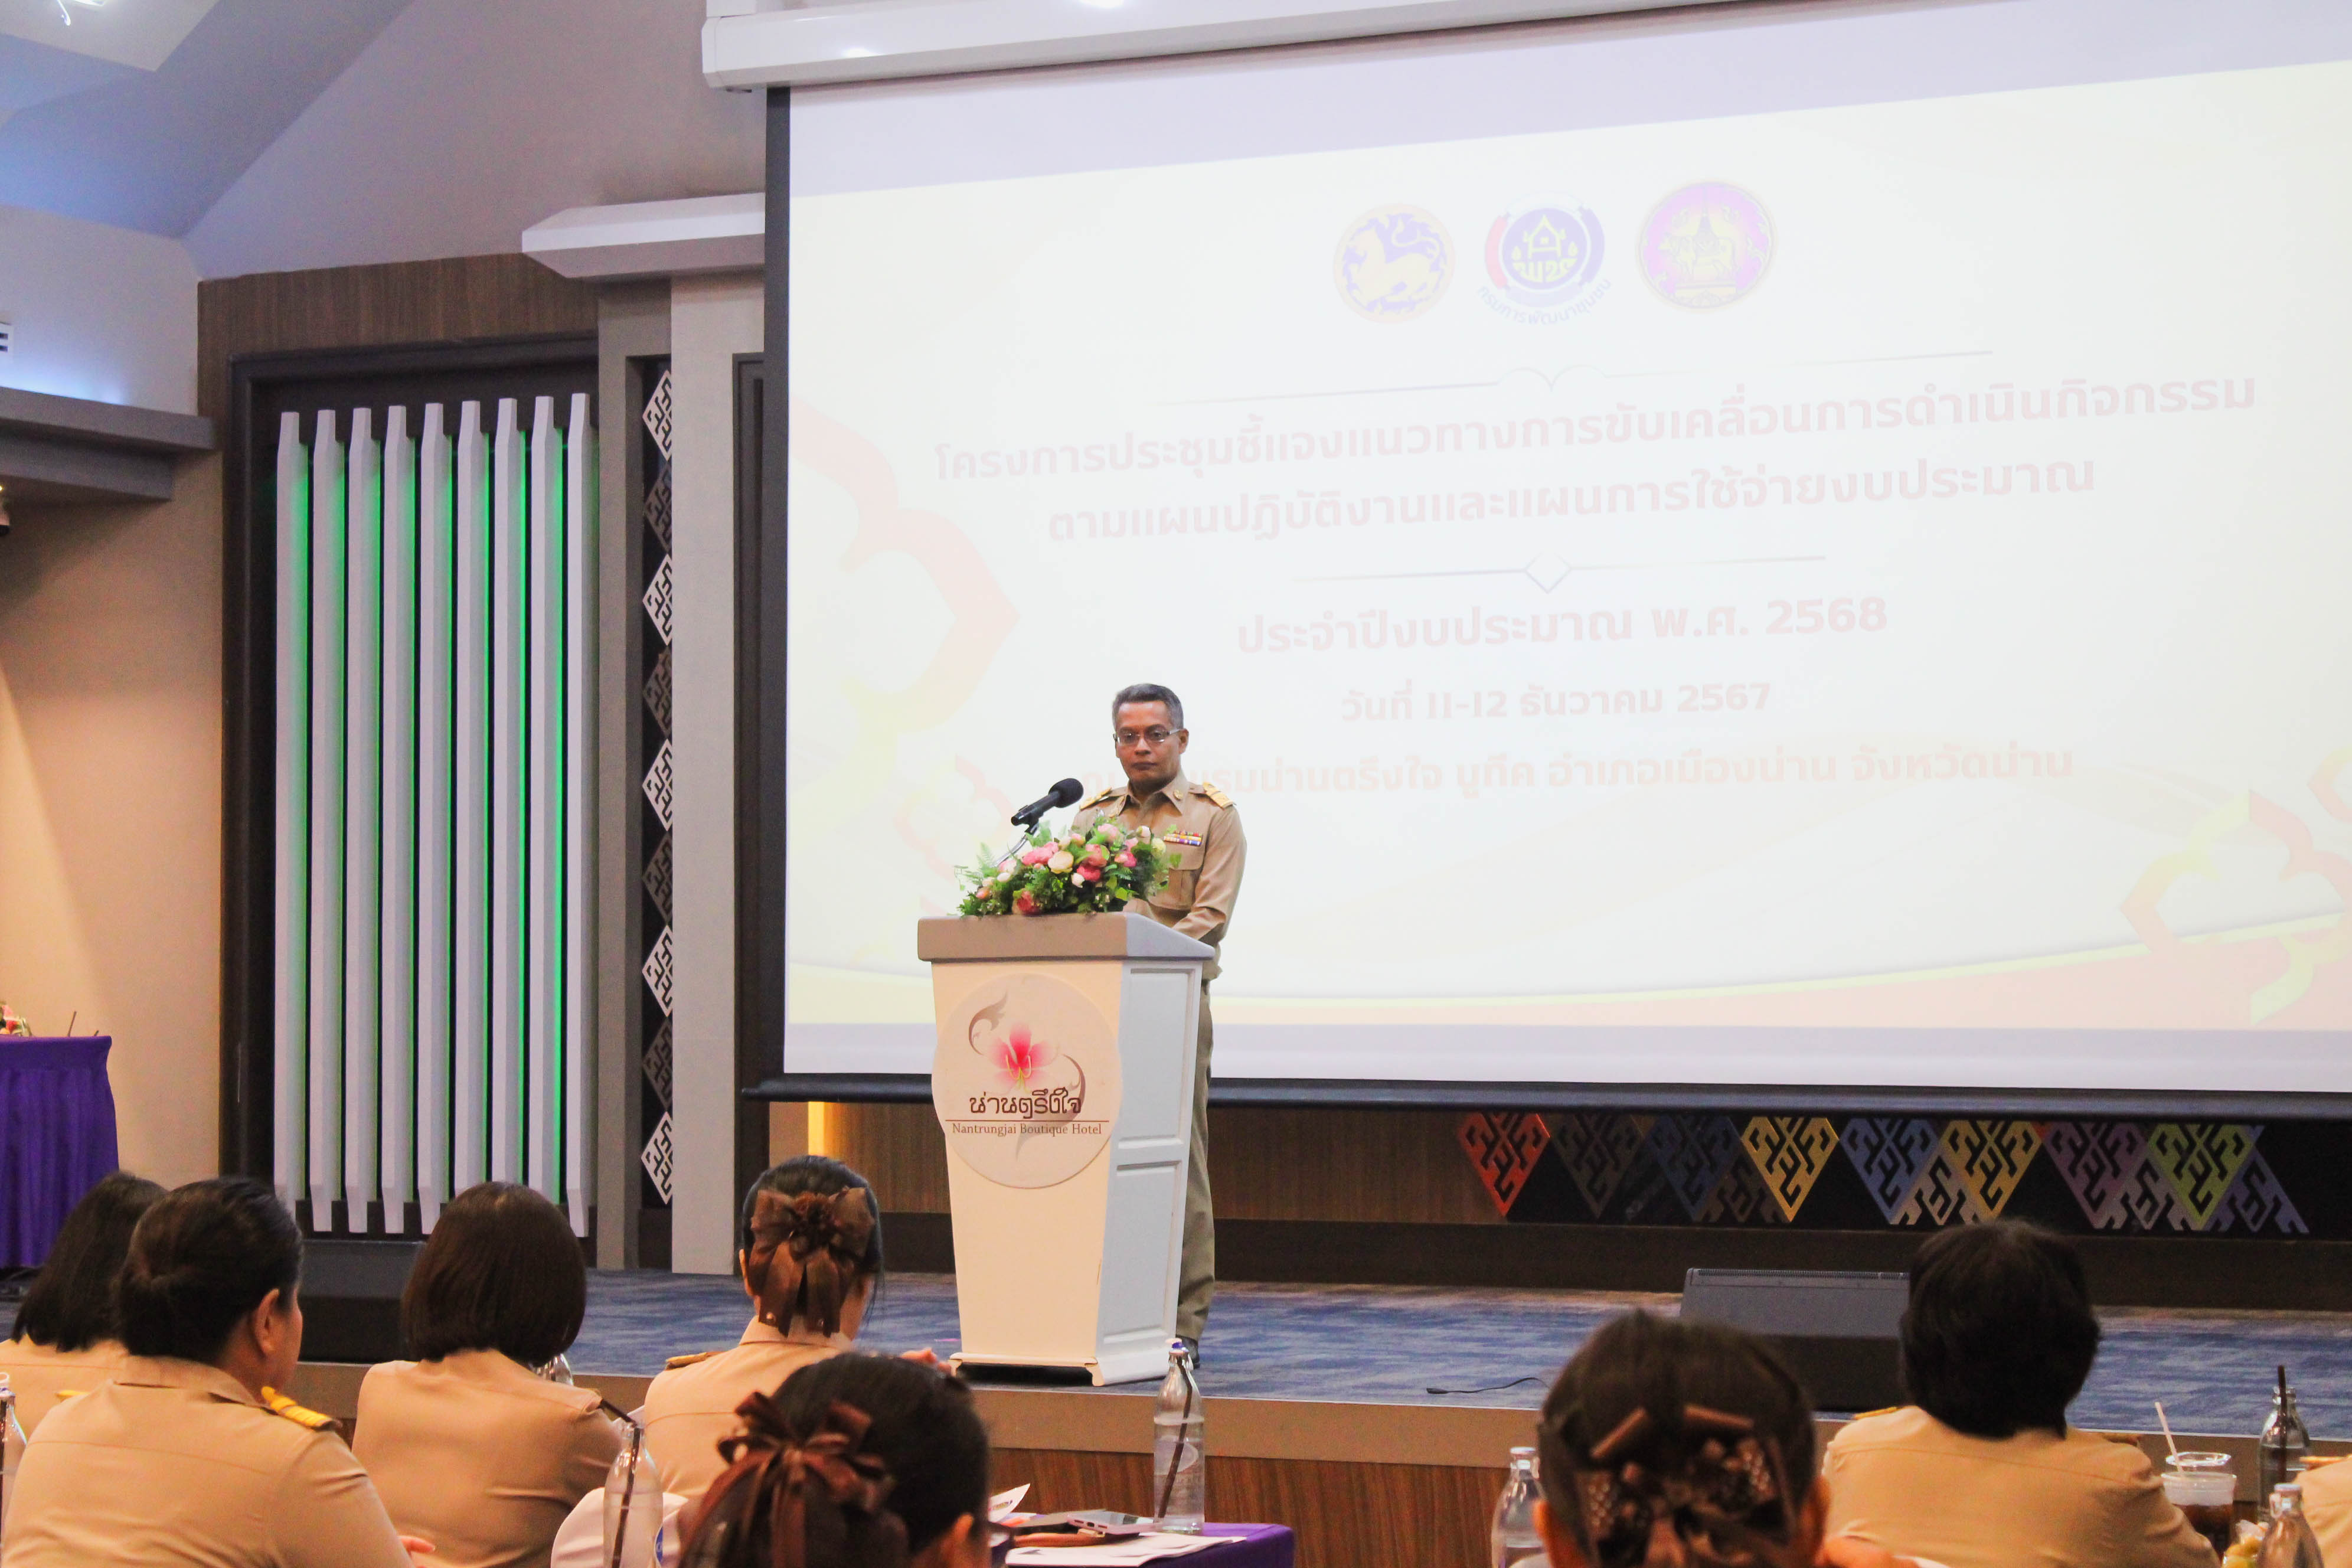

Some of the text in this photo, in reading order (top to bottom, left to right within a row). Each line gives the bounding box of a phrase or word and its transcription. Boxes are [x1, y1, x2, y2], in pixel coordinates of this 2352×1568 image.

[1237, 596, 1889, 654] ประจำปีงบประมาณ พ.ศ. 2568
[1341, 678, 1413, 721] วันที่
[1518, 681, 1664, 717] ธันวาคม
[1676, 681, 1772, 713] 2567
[1548, 745, 1837, 788] อำเภอเมืองน่าน
[1851, 739, 2073, 782] จังหวัดน่าน
[952, 1123, 1102, 1137] Nantrungjai Boutique Hotel
